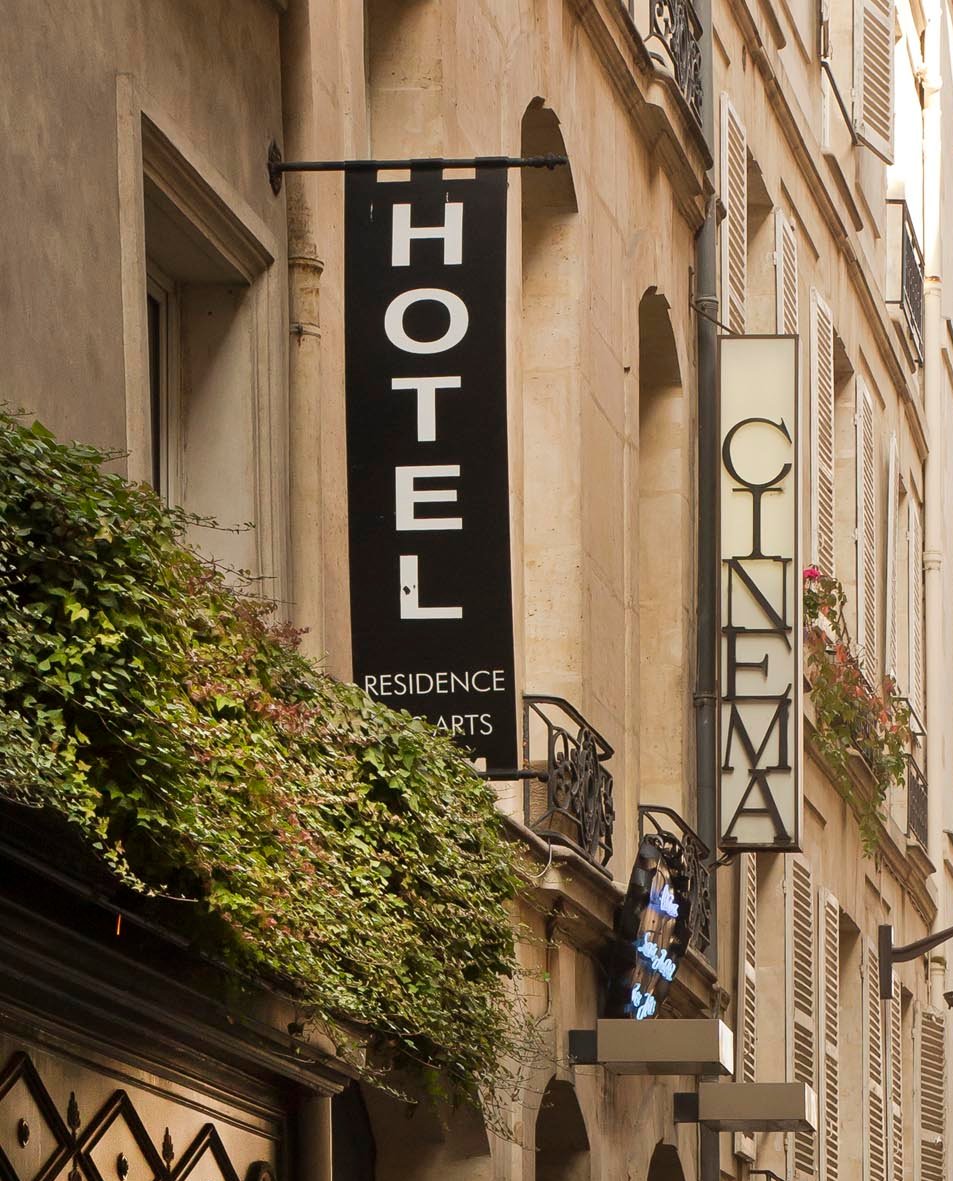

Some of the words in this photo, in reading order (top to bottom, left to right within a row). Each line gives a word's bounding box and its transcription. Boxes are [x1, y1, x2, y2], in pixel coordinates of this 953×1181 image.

[384, 202, 469, 620] HOTEL
[364, 670, 506, 697] RESIDENCE
[432, 713, 493, 738] ARTS
[721, 416, 793, 842] CINEMA
